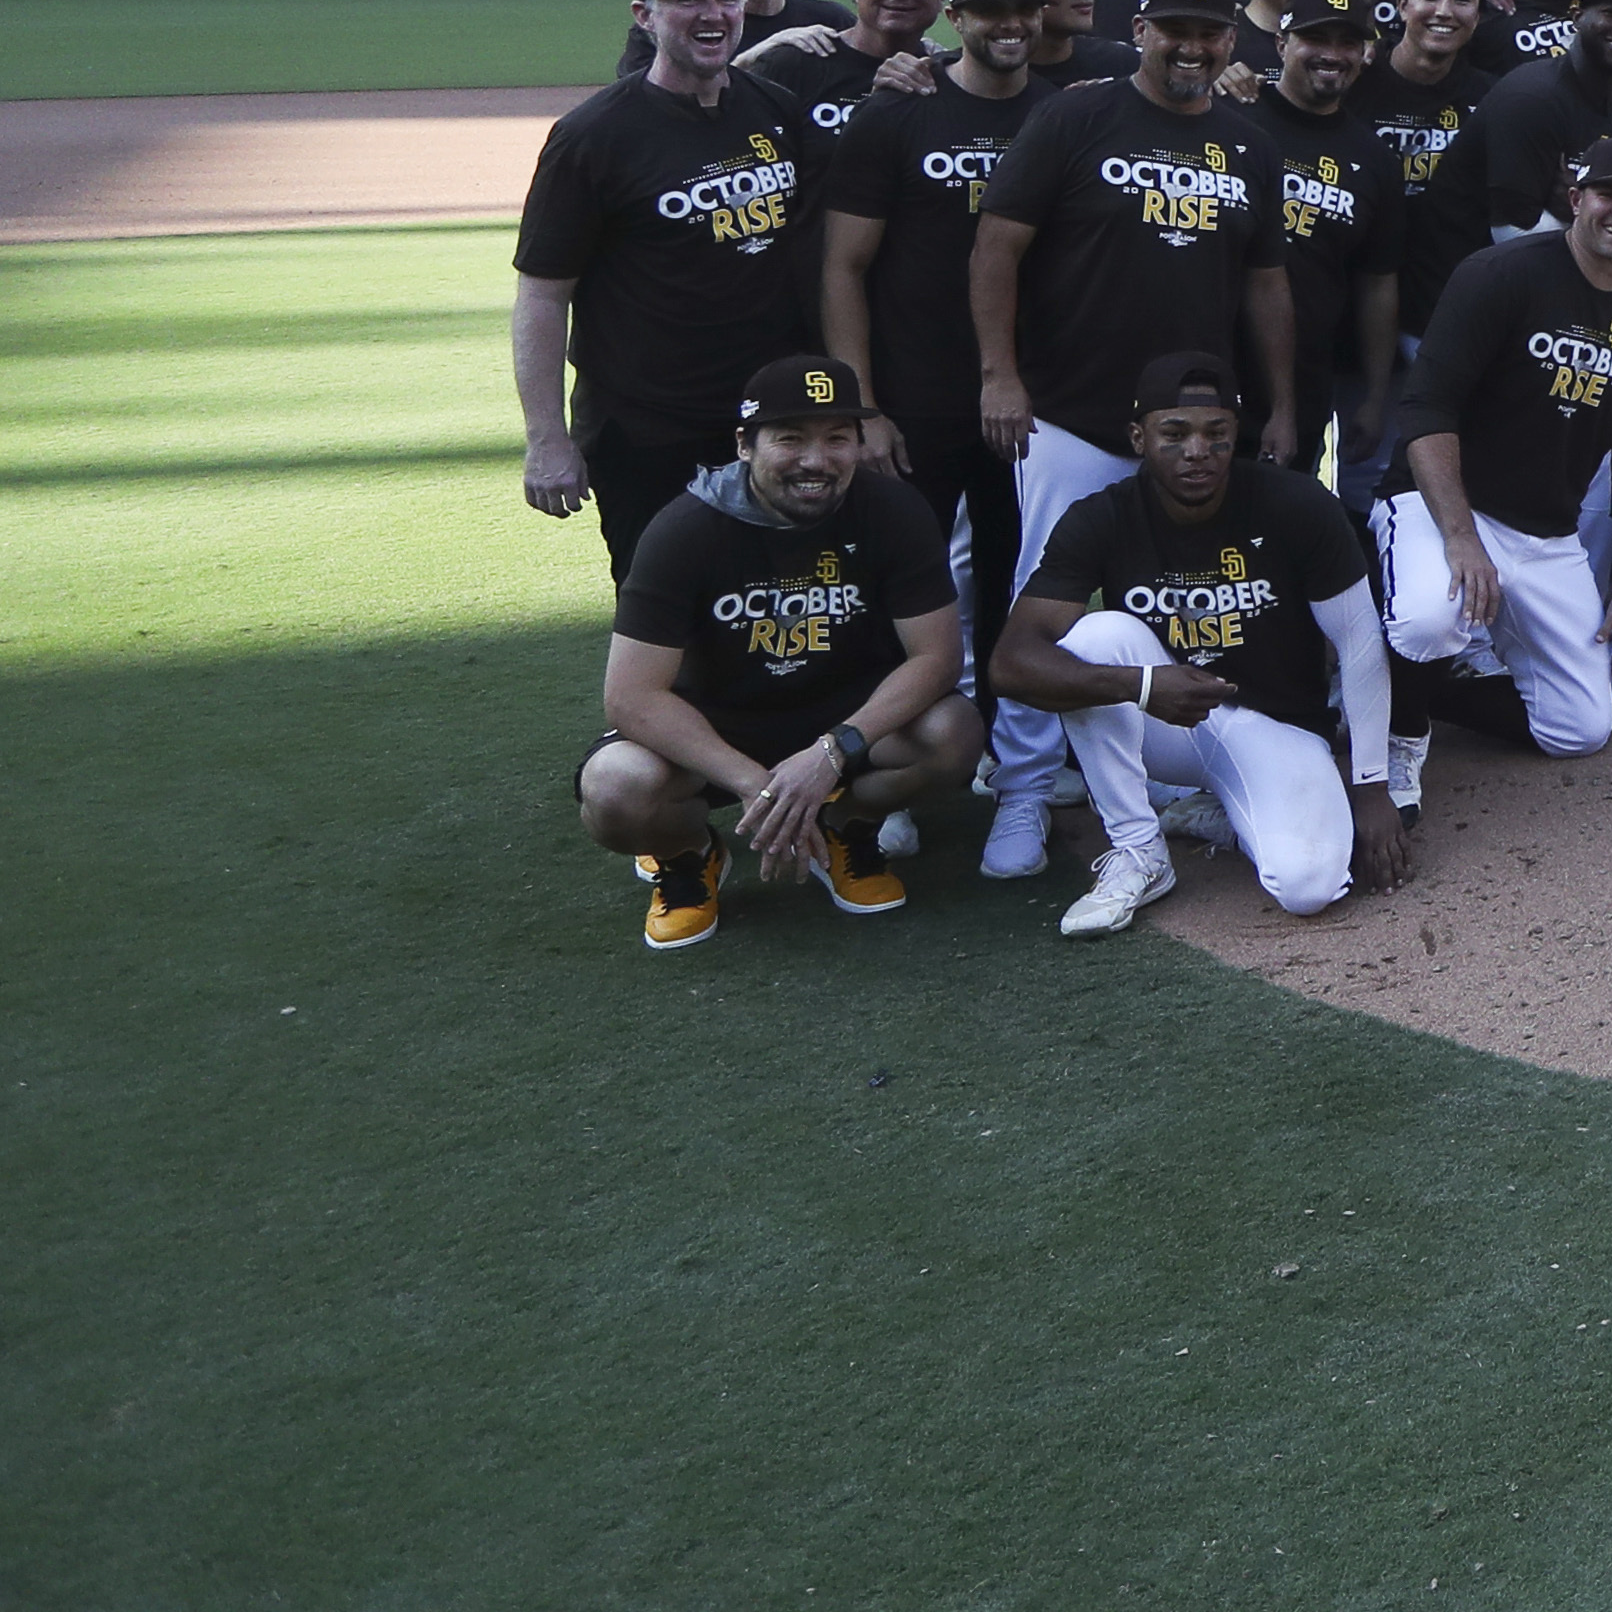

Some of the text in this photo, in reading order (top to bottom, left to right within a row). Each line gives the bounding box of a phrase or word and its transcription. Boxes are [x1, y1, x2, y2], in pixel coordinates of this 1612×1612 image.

[658, 163, 795, 219] OCTOBER
[1101, 157, 1249, 204] OCTOBER
[712, 193, 786, 242] RISE
[1143, 188, 1218, 231] RISE
[1550, 366, 1606, 407] RSE
[714, 585, 859, 621] OCTOBER
[1125, 579, 1271, 615] OCTOBER
[749, 616, 830, 658] RISE
